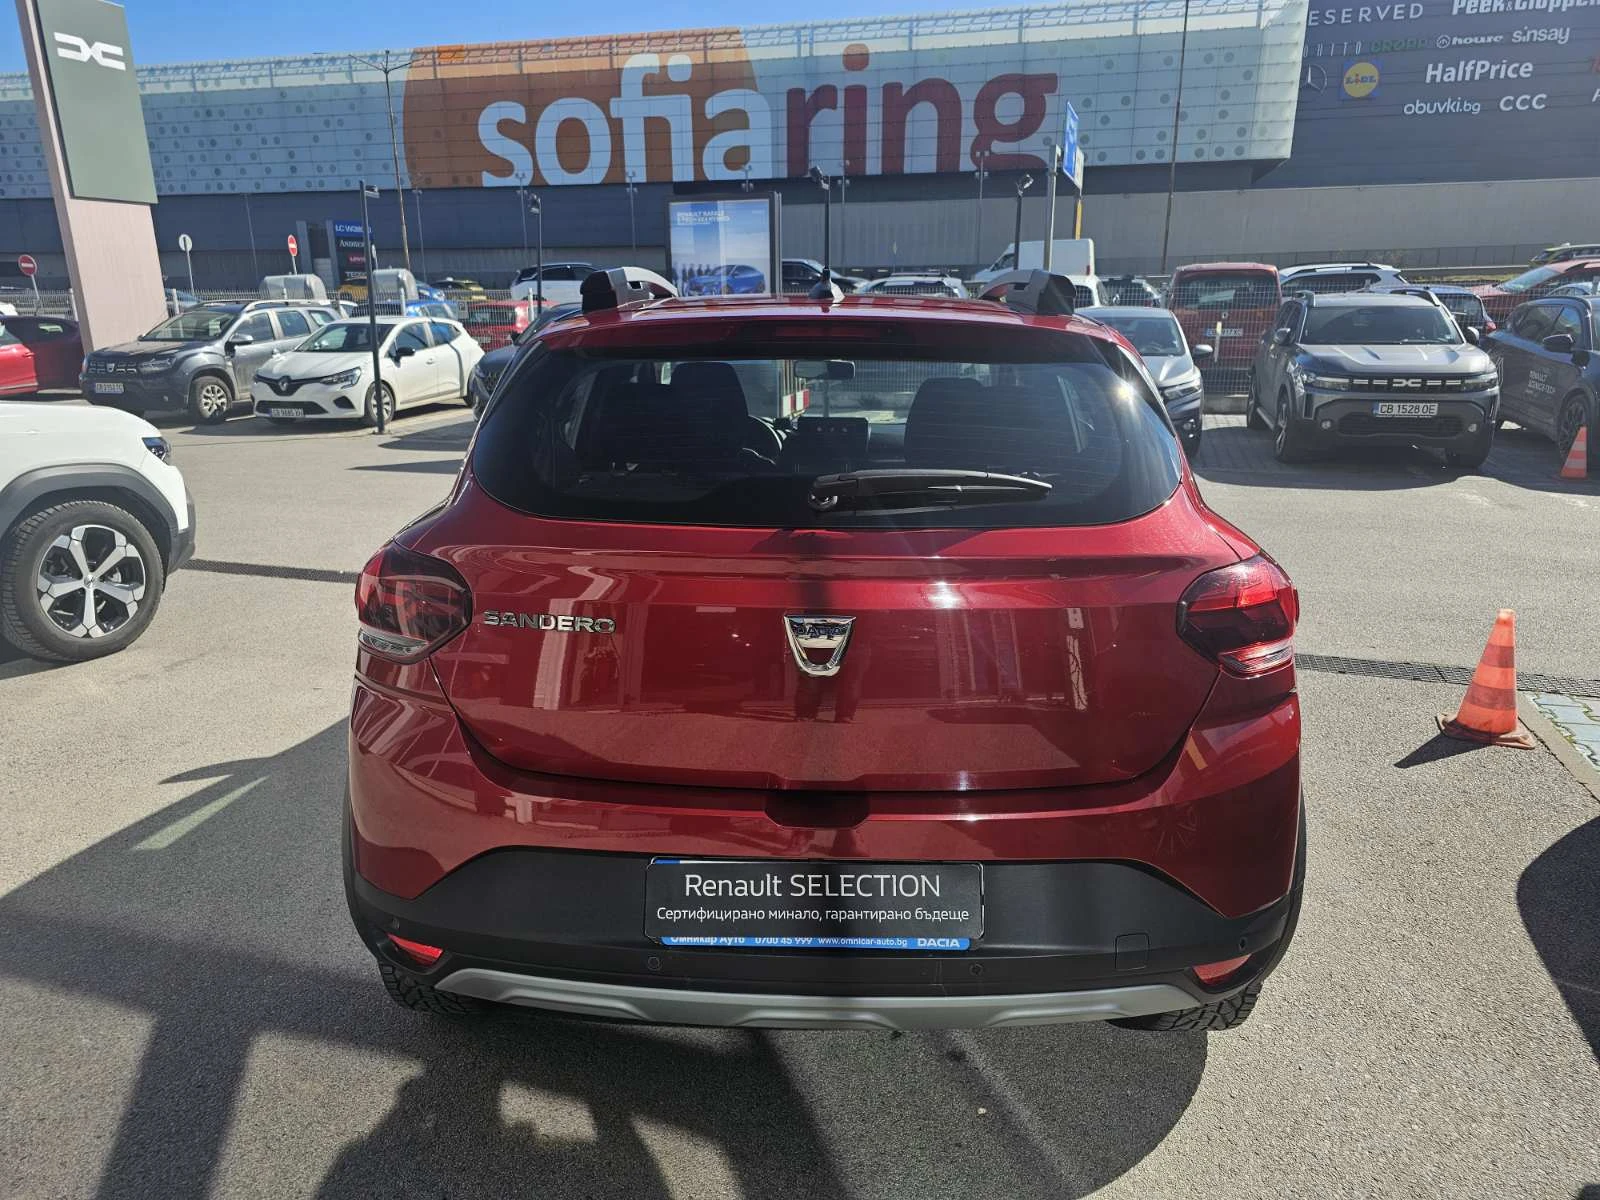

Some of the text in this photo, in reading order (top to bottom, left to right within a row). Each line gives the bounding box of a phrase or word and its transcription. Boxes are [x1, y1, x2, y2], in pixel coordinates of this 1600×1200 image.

[1307, 2, 1424, 26] ESERVED
[1511, 25, 1571, 45] sinsay
[1302, 40, 1362, 58] OHITO
[1425, 59, 1534, 84] HalfPrice
[1403, 97, 1481, 115] obuvki.bg
[1499, 93, 1548, 112] CCC
[1397, 404, 1420, 414] 1528
[483, 610, 617, 634] SANDERO
[684, 873, 941, 897] Renault SELECTION
[656, 906, 970, 923] Сертифицирано минало, гарантирано бъдеще
[916, 938, 961, 948] DACIA
